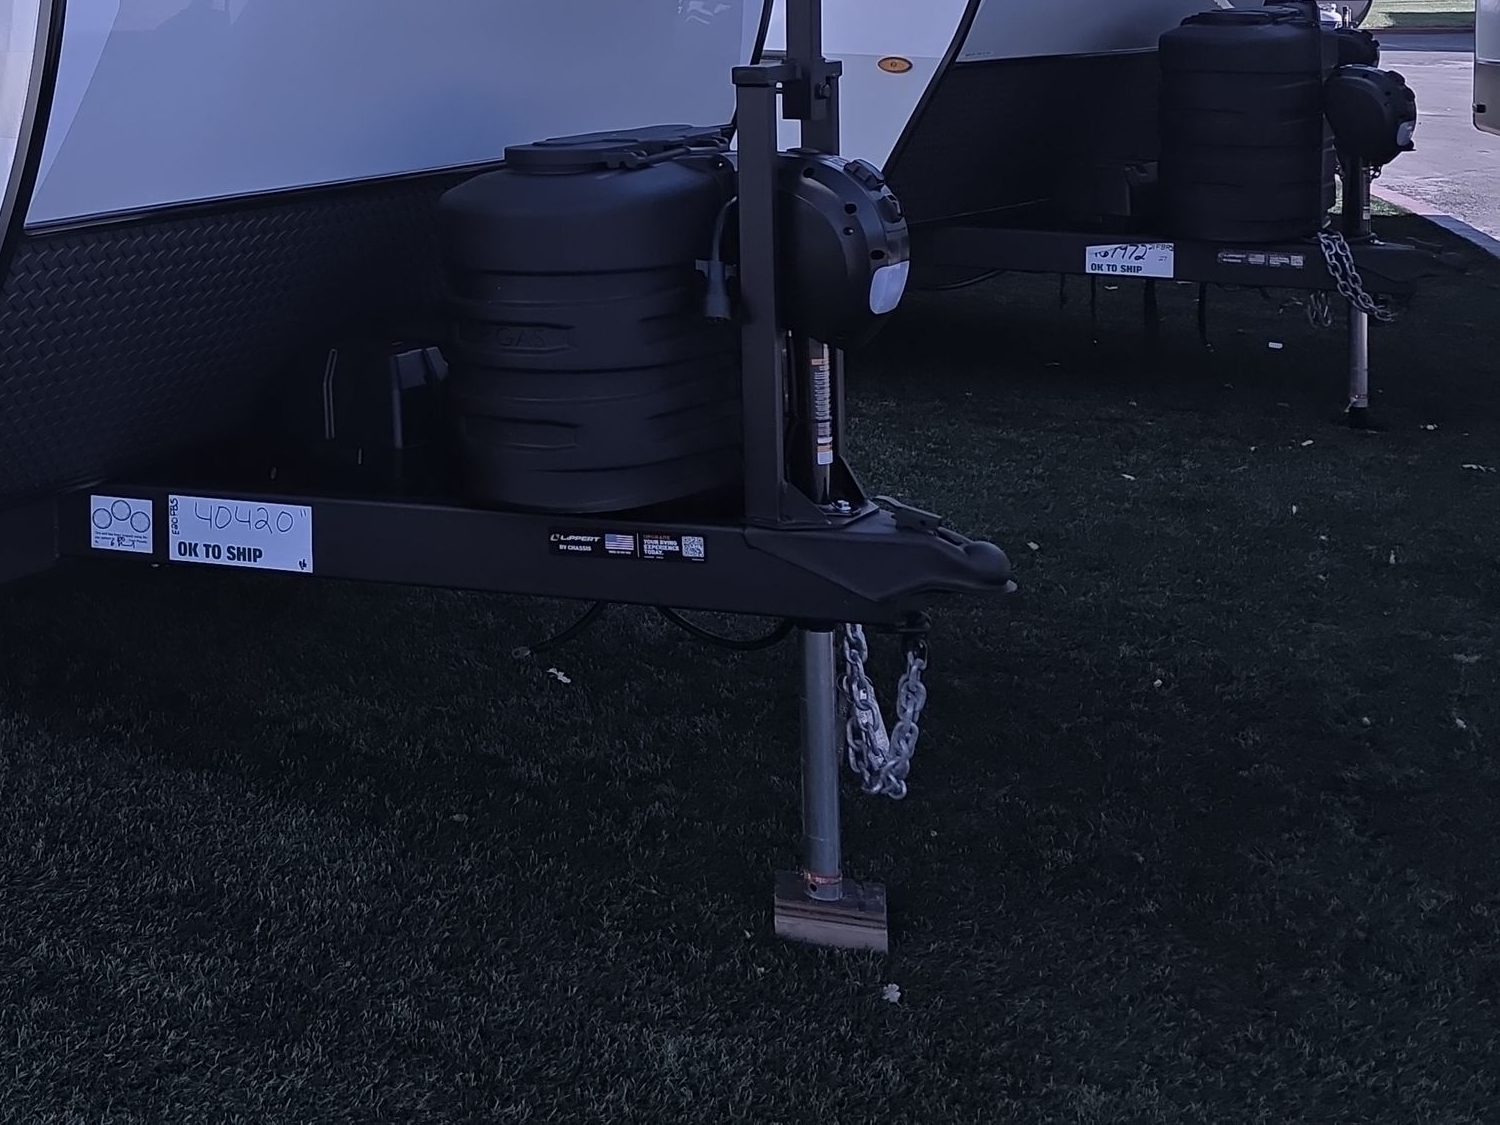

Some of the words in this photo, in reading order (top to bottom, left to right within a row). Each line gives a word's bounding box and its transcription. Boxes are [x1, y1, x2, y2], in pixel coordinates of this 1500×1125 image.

[1090, 262, 1104, 272] OK
[1106, 263, 1118, 272] TO
[1120, 264, 1143, 274] SHIP
[177, 540, 199, 558] OK
[203, 543, 222, 561] TO
[226, 545, 264, 563] SHIP
